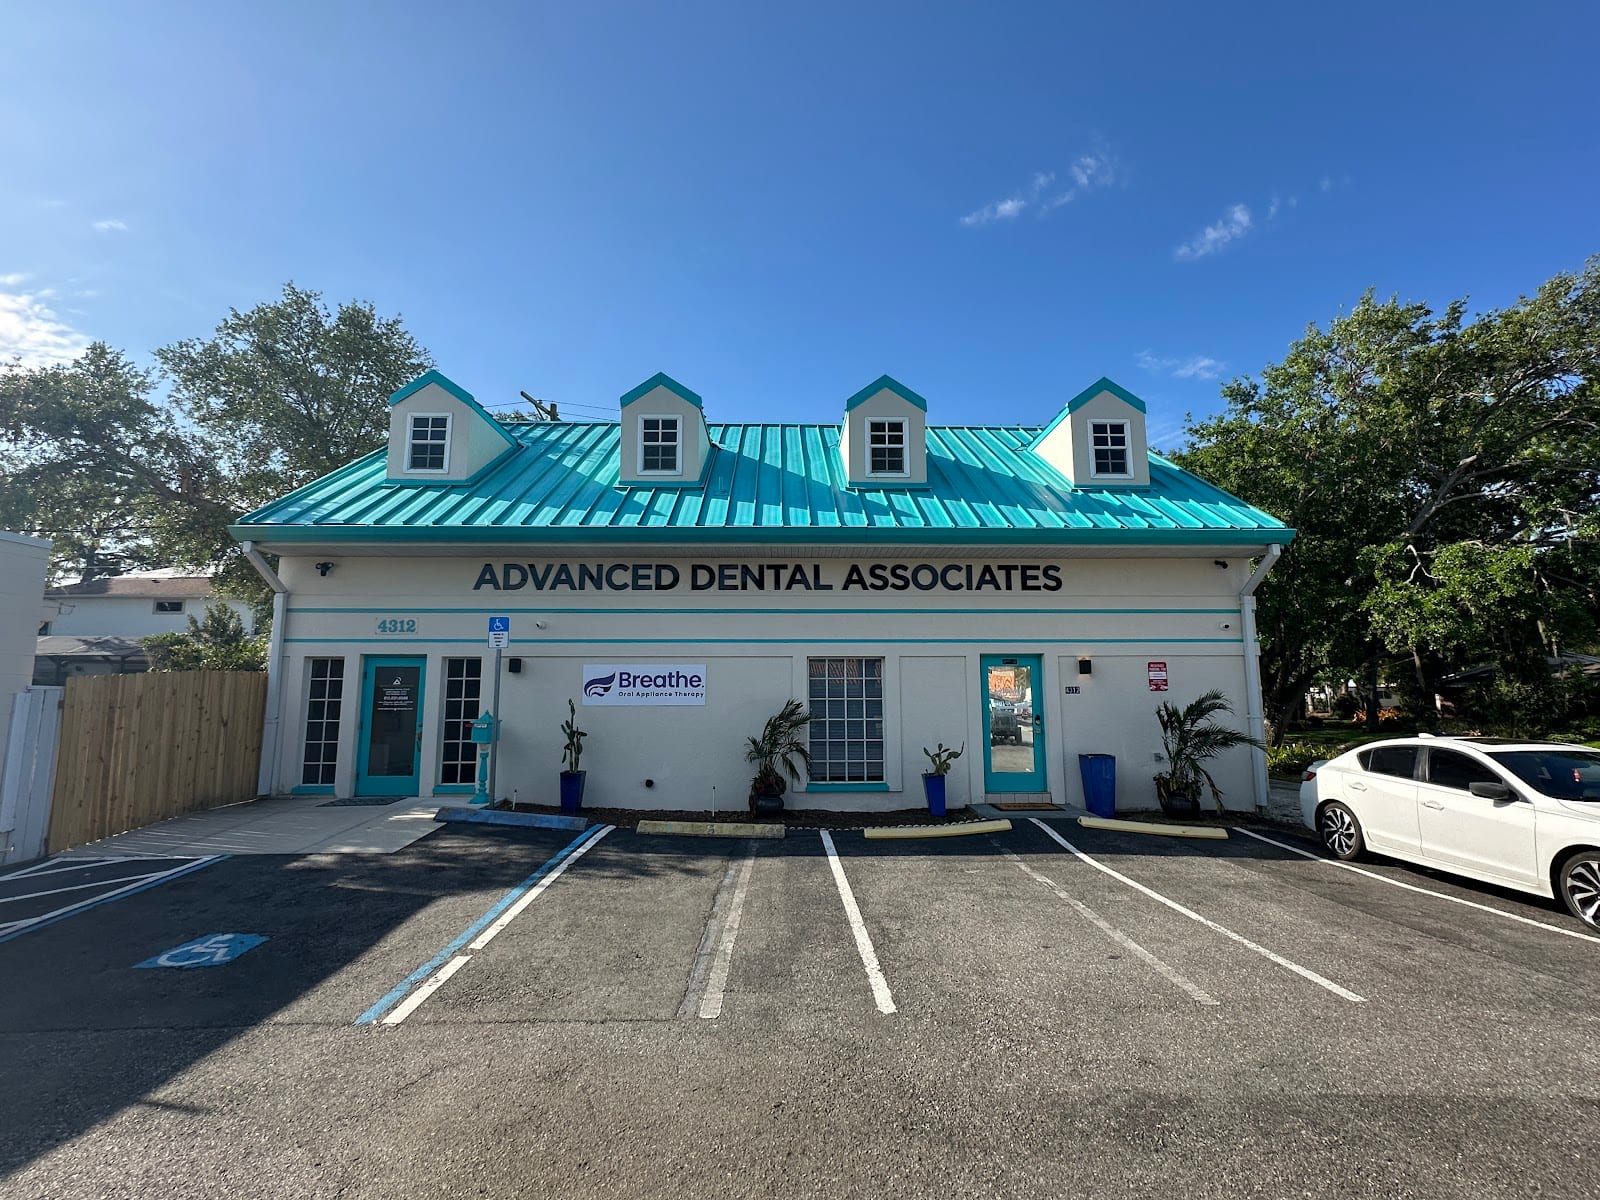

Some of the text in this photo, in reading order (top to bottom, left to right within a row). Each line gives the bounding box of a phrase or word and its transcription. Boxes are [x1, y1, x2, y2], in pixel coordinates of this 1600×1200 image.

[472, 563, 1063, 592] ADVANCED DENTAL ASSOCIATES
[377, 619, 417, 633] 4312
